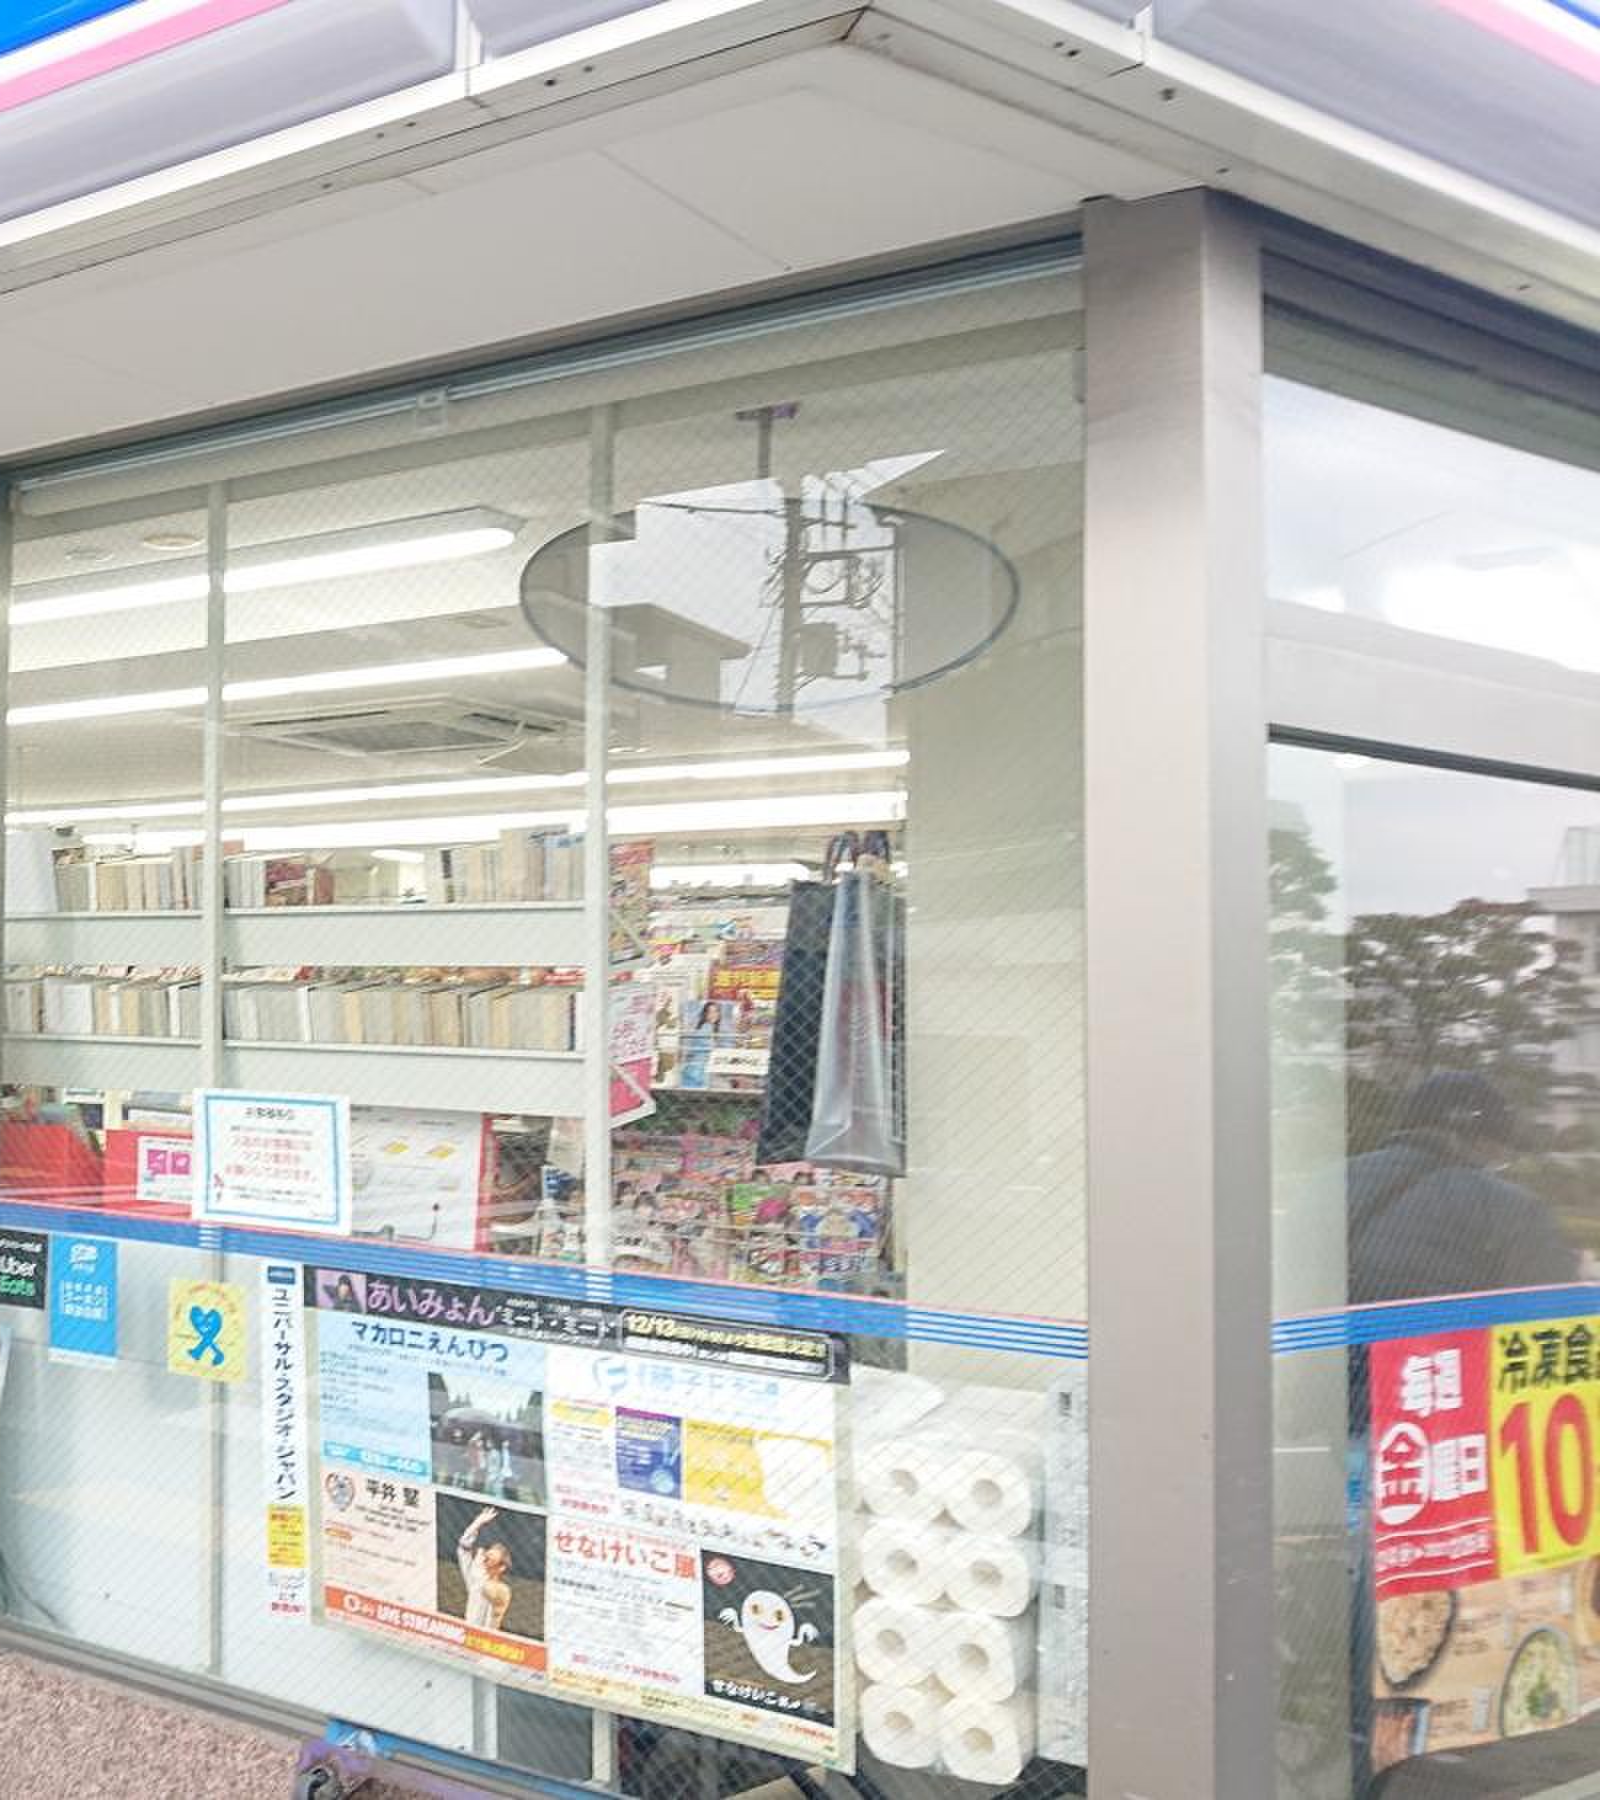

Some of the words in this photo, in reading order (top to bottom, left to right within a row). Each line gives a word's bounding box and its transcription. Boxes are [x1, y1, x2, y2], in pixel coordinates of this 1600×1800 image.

[0, 1254, 37, 1277] Uber
[0, 1274, 36, 1297] Eats
[367, 1279, 495, 1327] あいみょん
[351, 1320, 509, 1362] マカロニえんぴつ
[1497, 1323, 1600, 1394] 冷凍食
[1500, 1393, 1593, 1554] 10
